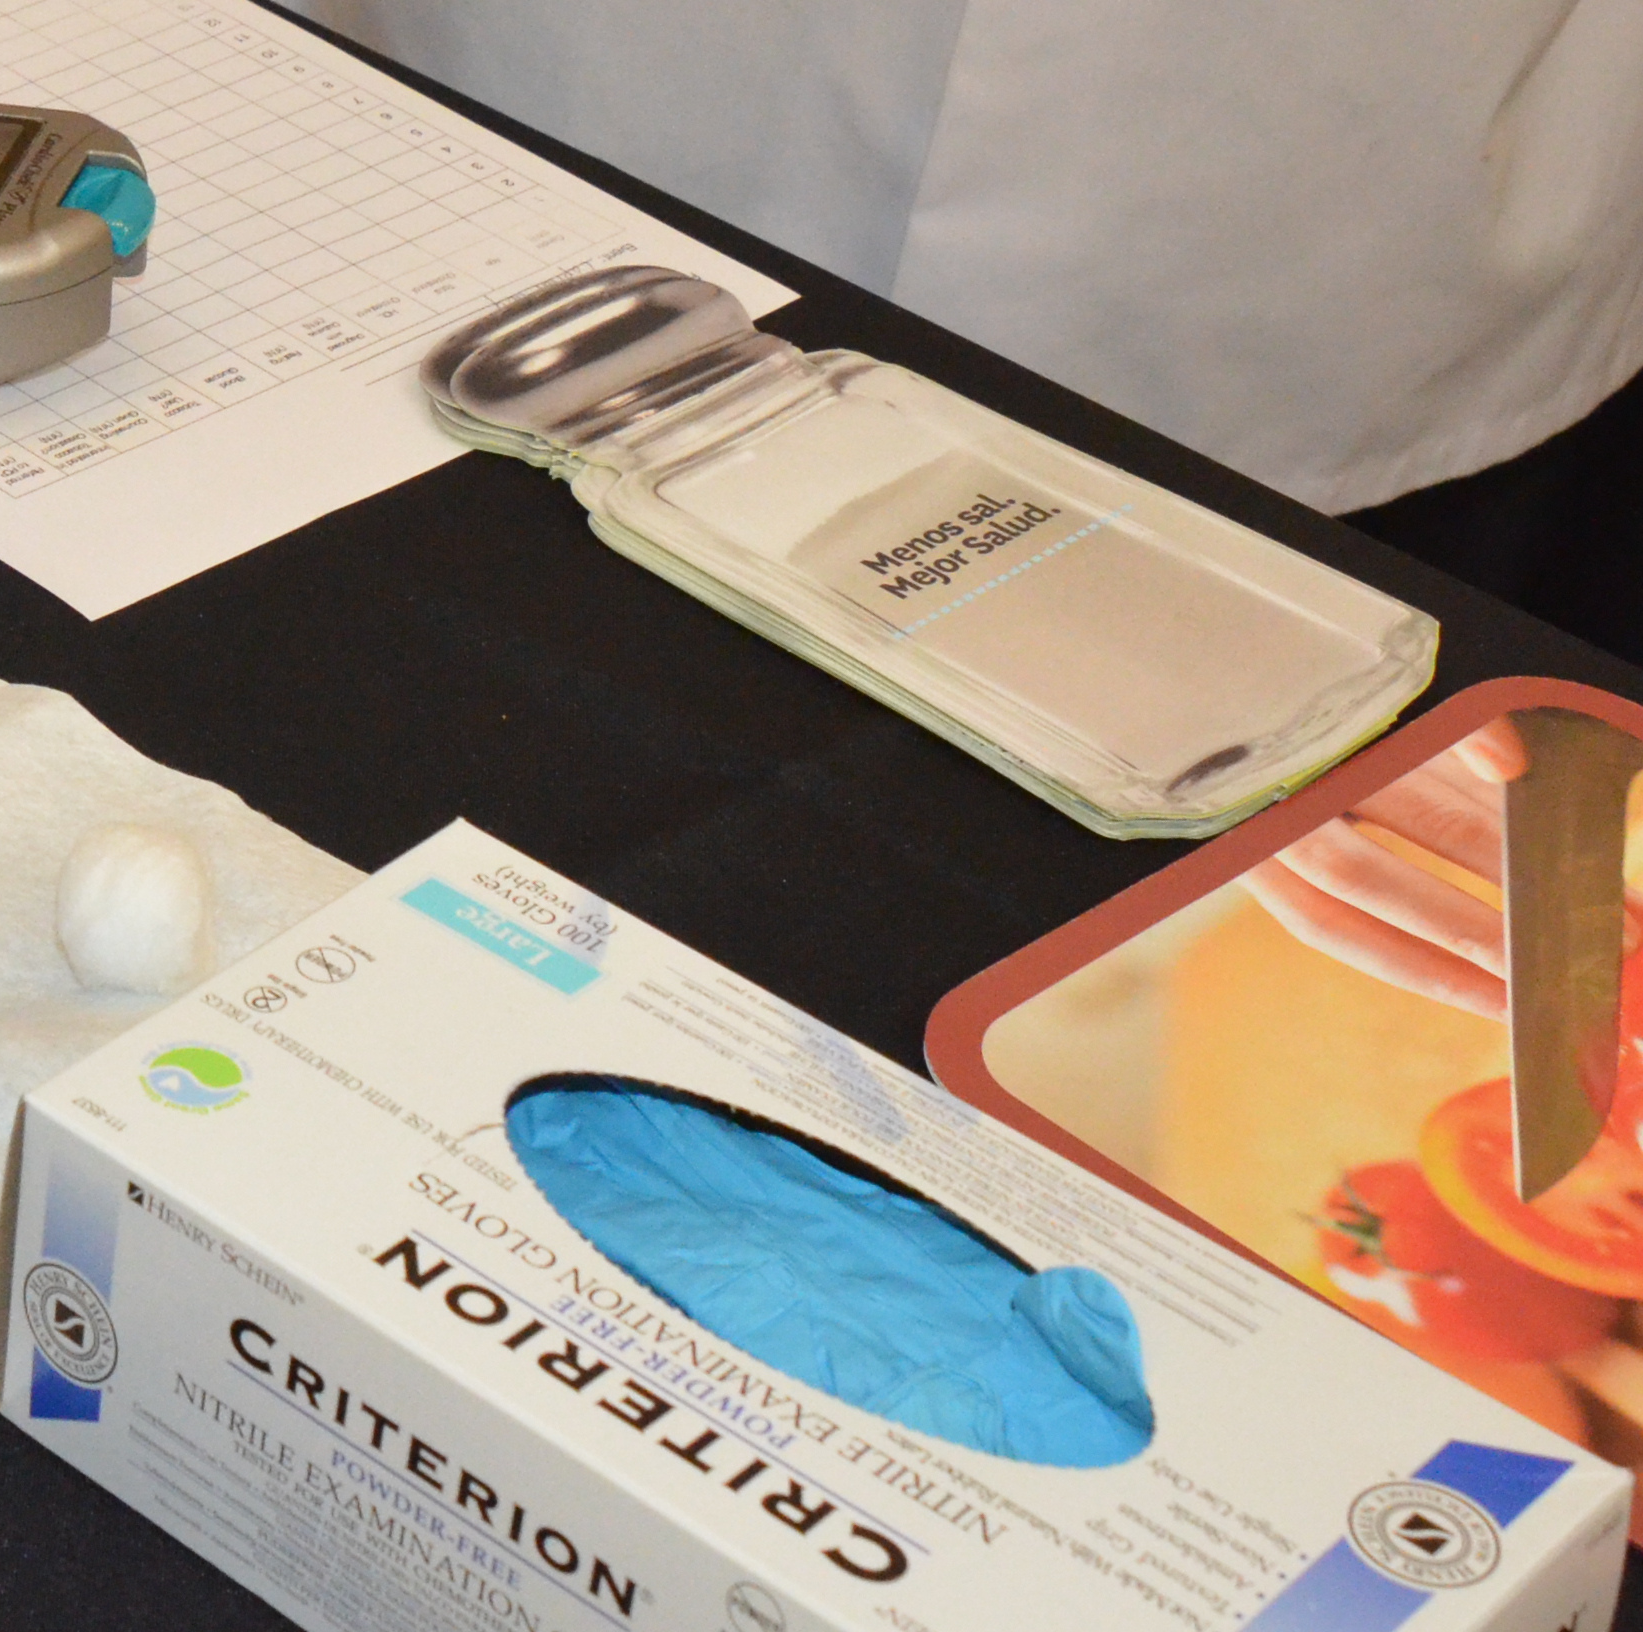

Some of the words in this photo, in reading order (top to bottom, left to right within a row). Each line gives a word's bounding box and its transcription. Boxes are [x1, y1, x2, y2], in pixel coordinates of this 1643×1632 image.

[860, 518, 965, 575] Menos
[957, 492, 1016, 526] sal.
[879, 548, 970, 600] Mejor
[962, 502, 1062, 556] Salud.
[454, 902, 556, 965] Large
[470, 871, 558, 926] Gloves
[555, 917, 607, 953] 100
[200, 992, 251, 1025] DRUGS
[252, 1020, 365, 1093] CHEMOTHERAPY
[362, 1086, 403, 1118] WITH
[402, 1112, 433, 1136] USE
[463, 1152, 518, 1193] TESTED
[145, 1192, 217, 1254] HENRY
[220, 1241, 301, 1307] SCHEIN
[408, 1170, 558, 1271] GLOVES
[547, 1294, 797, 1451] POWDER-FREE
[556, 1265, 842, 1444] EXAMINATION
[372, 1235, 911, 1586] CRITERION
[173, 1372, 297, 1474] NITRILE
[305, 1462, 543, 1632] EXAMINATION
[229, 1318, 638, 1617] CRITERION
[837, 1435, 1009, 1546] NITRILE
[330, 1448, 521, 1590] POWDER-FREE
[364, 1525, 411, 1569] WITH
[1085, 1518, 1135, 1554] Grip
